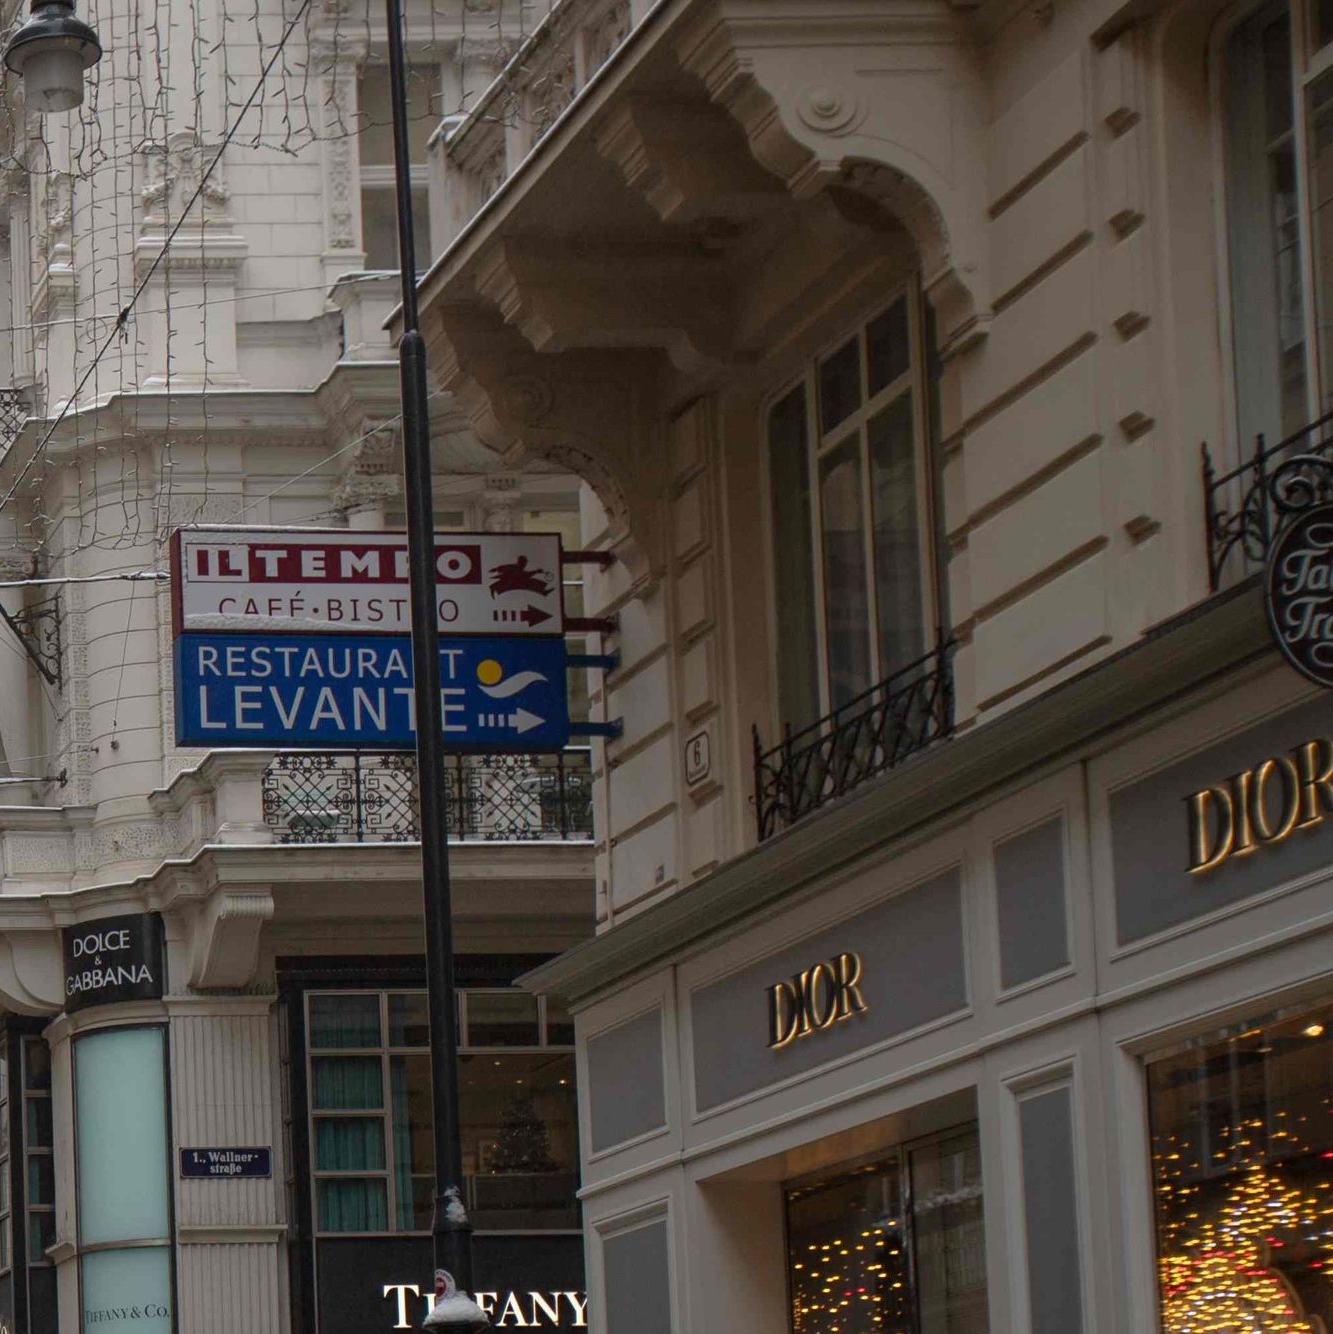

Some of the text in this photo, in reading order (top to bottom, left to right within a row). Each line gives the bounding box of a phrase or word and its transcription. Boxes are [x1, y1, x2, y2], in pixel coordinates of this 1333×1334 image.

[196, 549, 243, 577] IL
[327, 599, 460, 622] BISTO
[198, 645, 464, 681] RESTAURAT
[694, 740, 701, 767] 6
[1182, 738, 1333, 874] DIOR
[73, 929, 131, 958] DOLCE
[94, 954, 103, 966] &
[66, 963, 154, 997] GABBANA
[765, 951, 869, 1050] DIOR
[209, 1163, 243, 1177] straße
[383, 1284, 588, 1329] TIFANY
